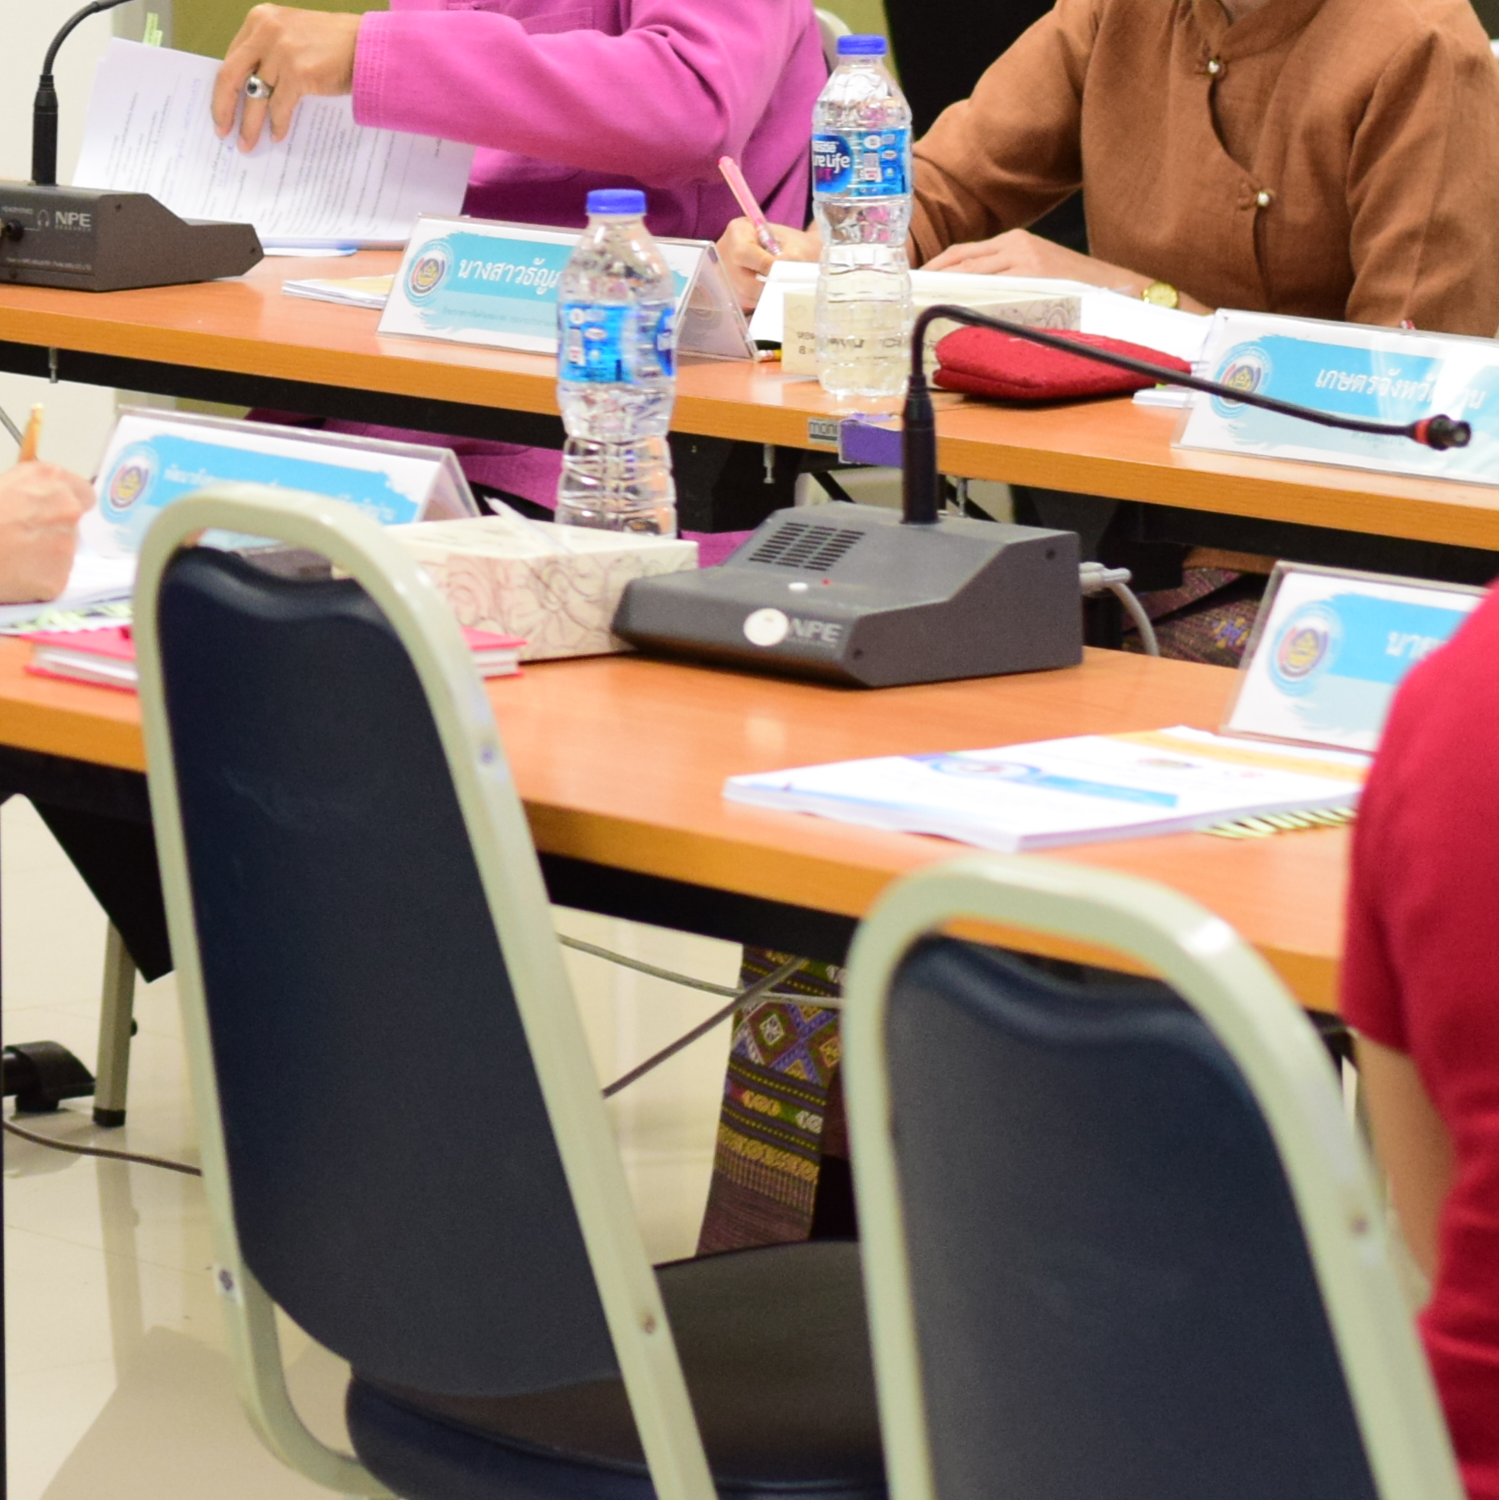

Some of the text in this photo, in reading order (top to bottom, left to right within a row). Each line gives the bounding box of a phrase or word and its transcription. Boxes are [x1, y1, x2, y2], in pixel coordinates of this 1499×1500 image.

[55, 211, 92, 227] NPE
[808, 421, 838, 435] mon
[790, 617, 843, 643] NPE
